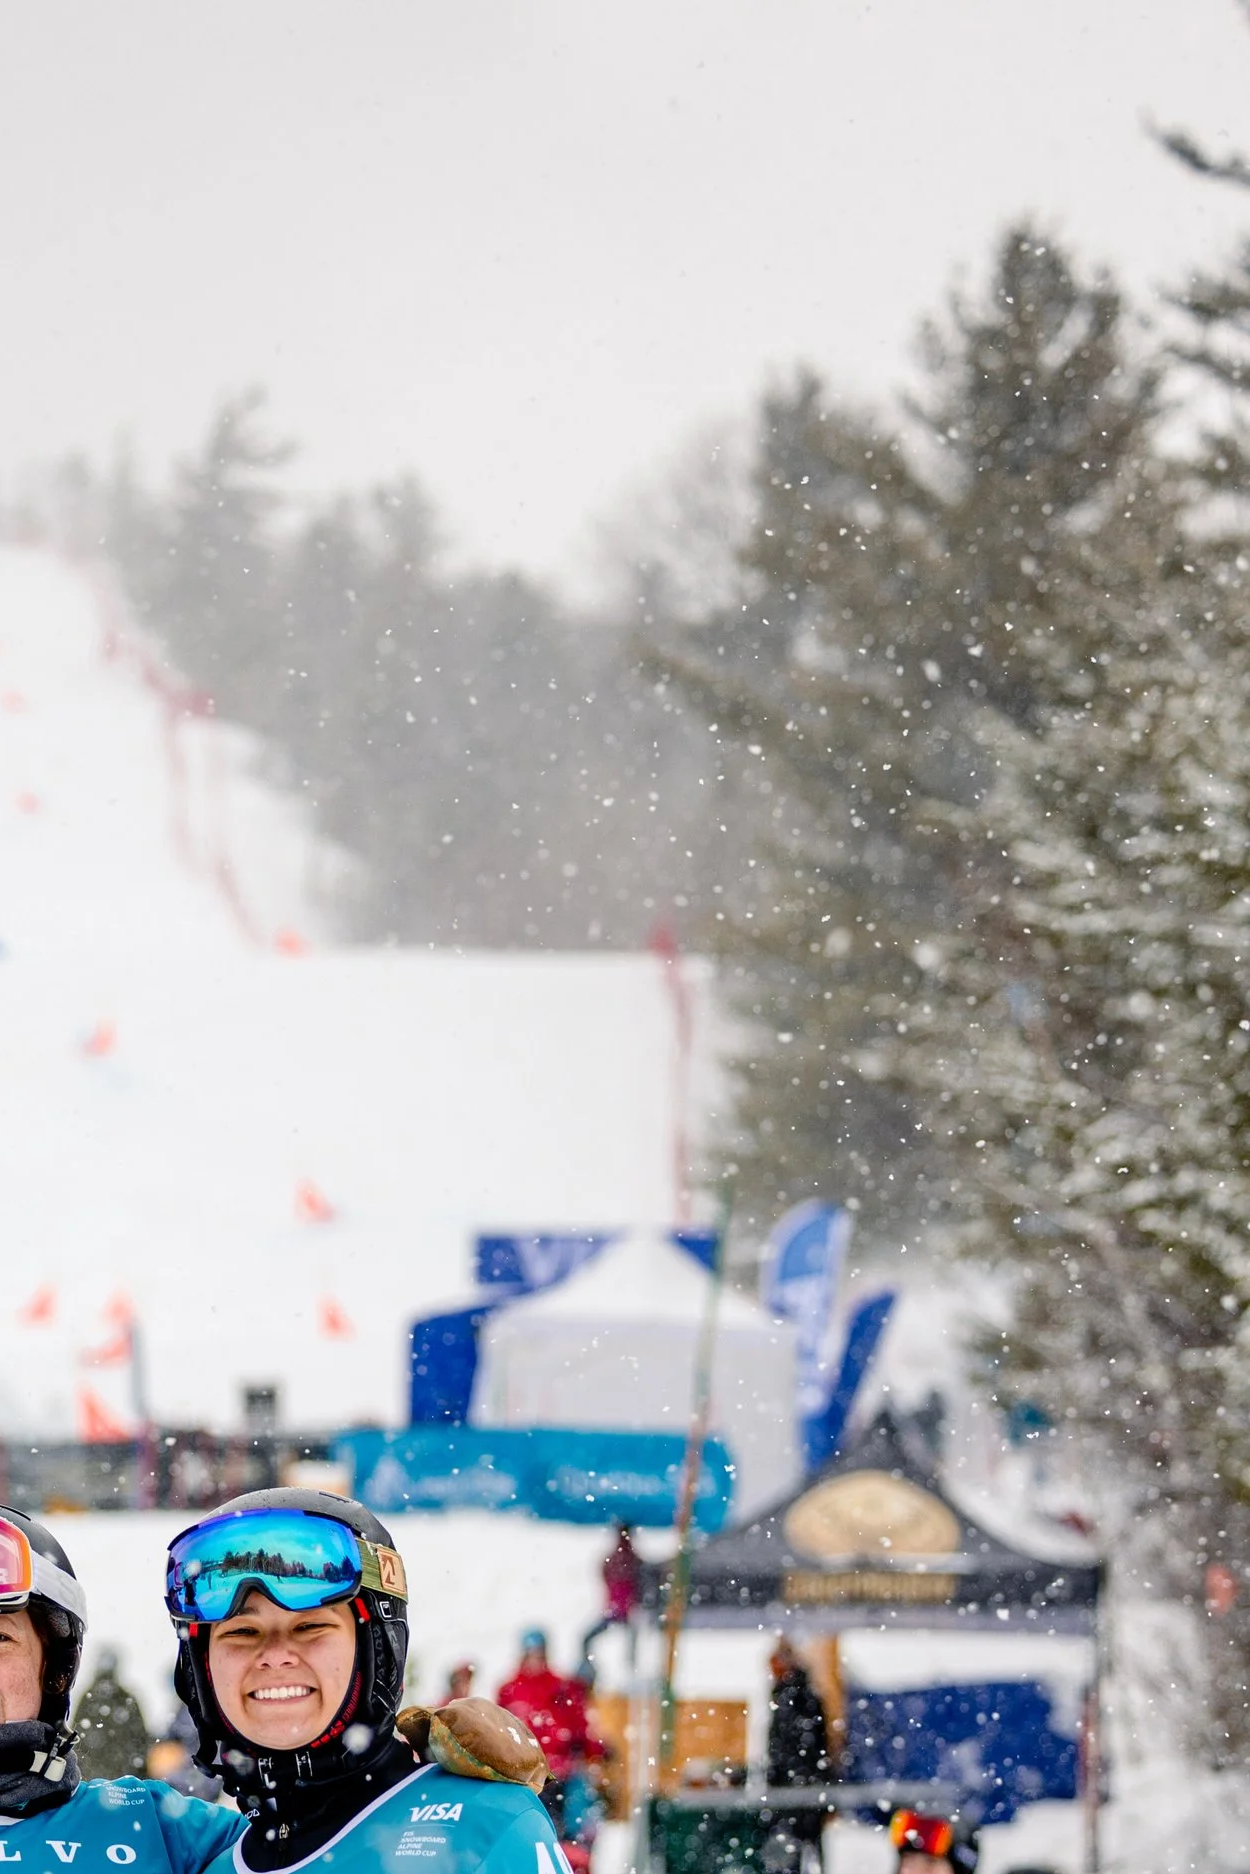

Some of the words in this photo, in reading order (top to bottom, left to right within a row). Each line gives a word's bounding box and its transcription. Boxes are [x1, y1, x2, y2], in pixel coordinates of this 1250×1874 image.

[108, 1798, 130, 1806] WORLD
[409, 1802, 464, 1823] VISA
[395, 1849, 421, 1857] WORLD
